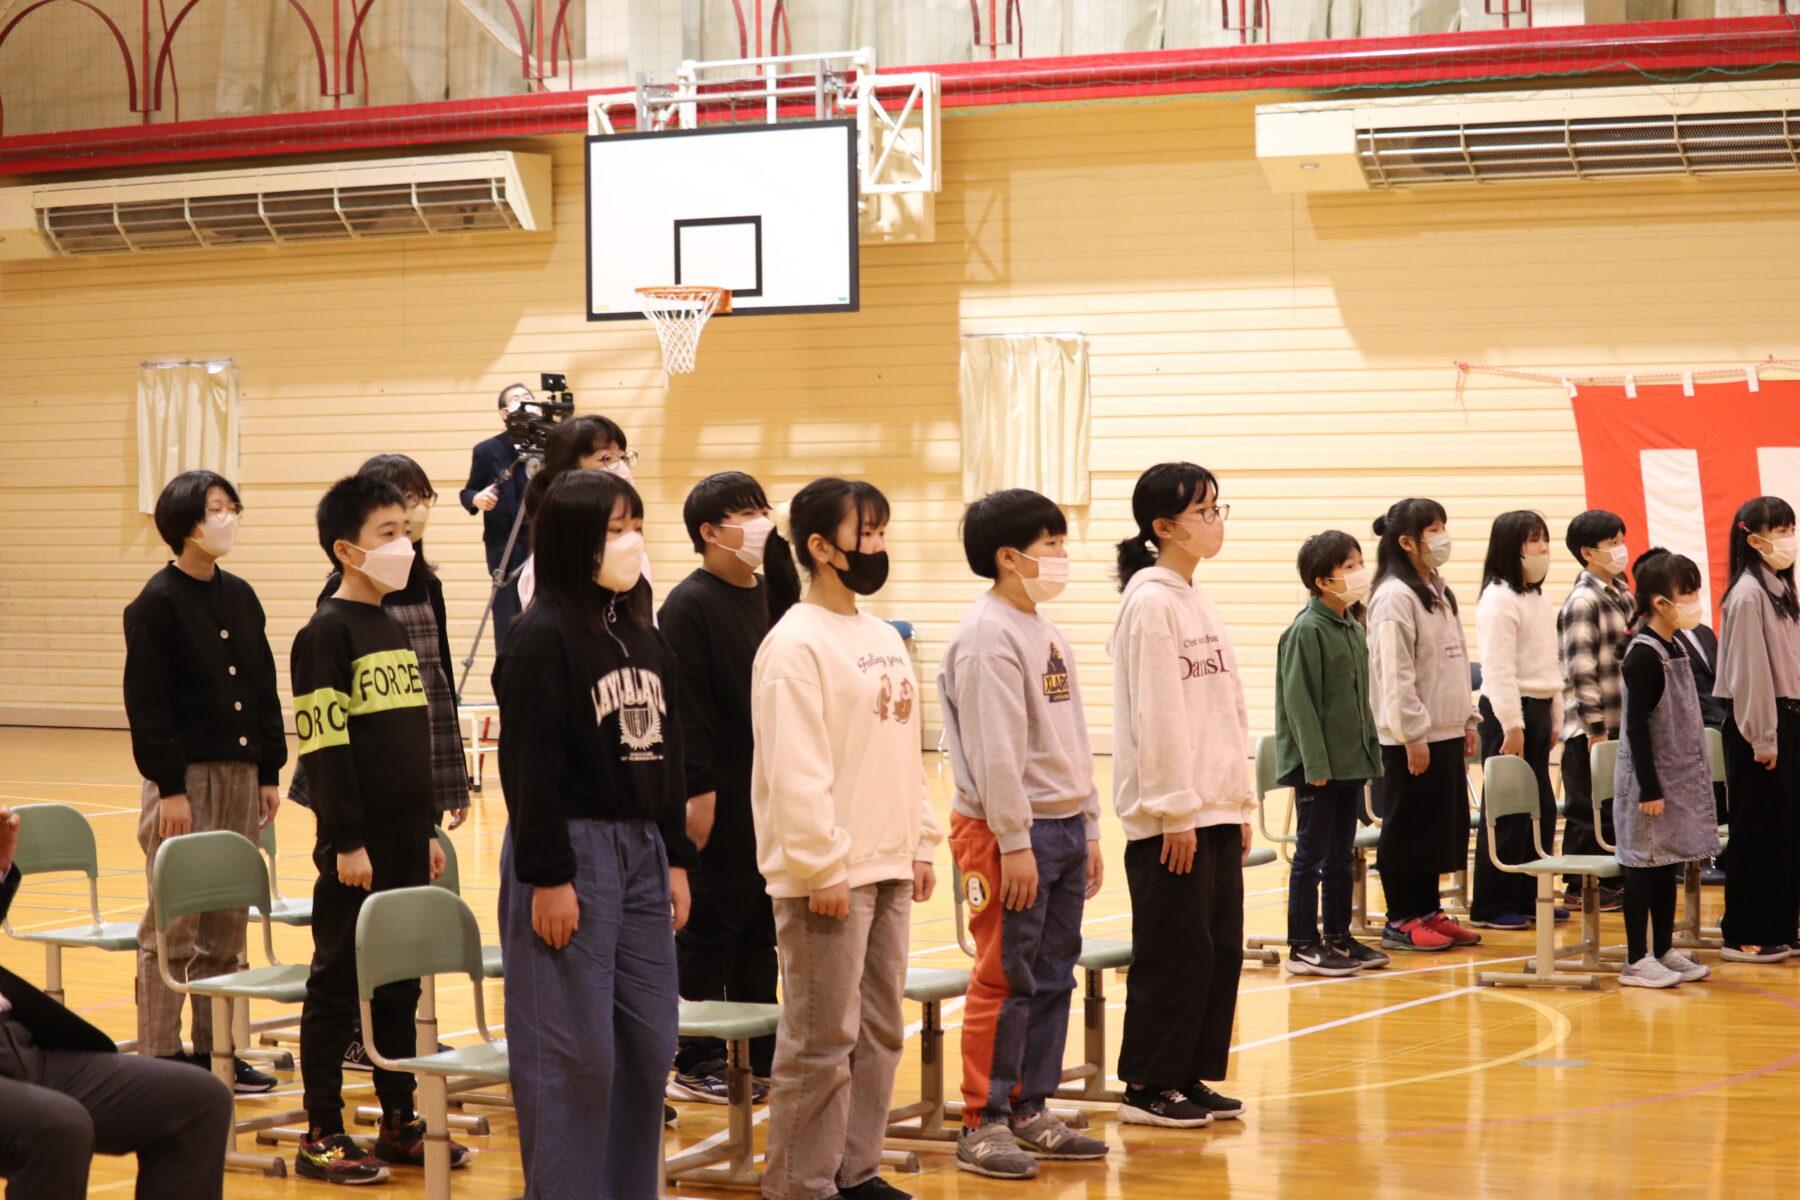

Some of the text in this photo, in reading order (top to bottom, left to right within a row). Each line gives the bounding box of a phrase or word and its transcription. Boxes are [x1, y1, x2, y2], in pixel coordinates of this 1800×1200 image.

[359, 663, 423, 702] FORCE
[1035, 1129, 1062, 1148] N
[971, 1142, 992, 1159] N
